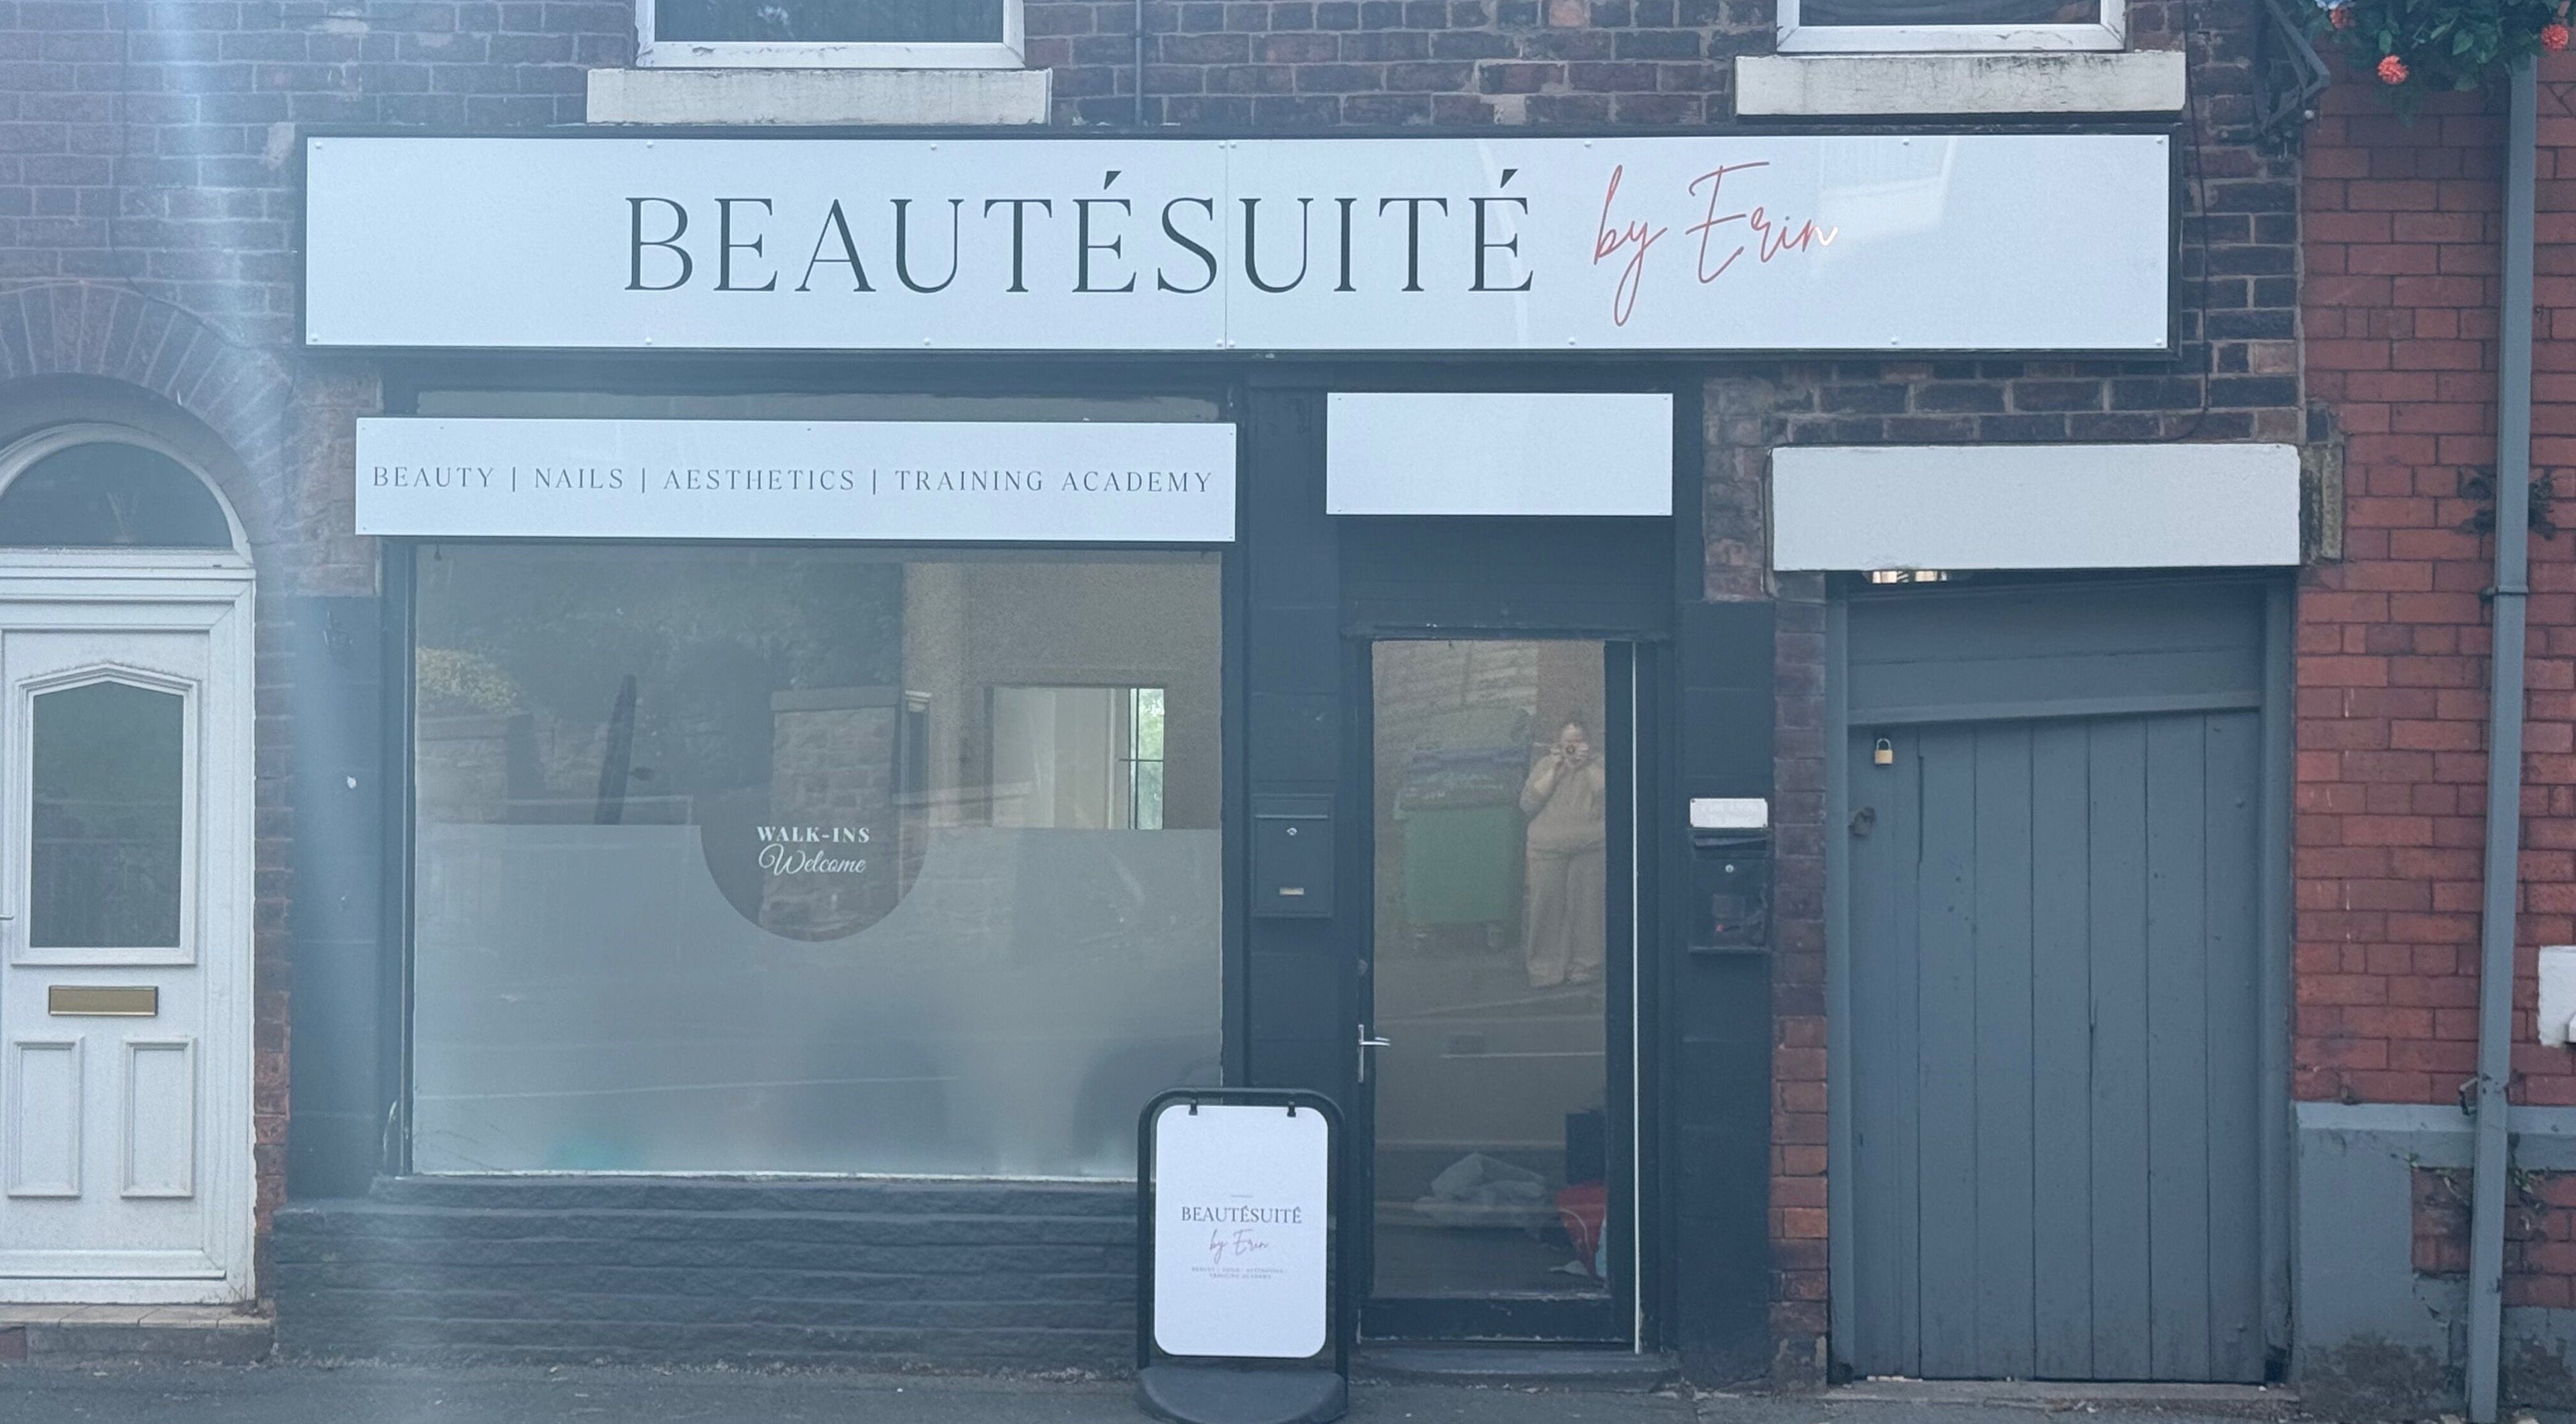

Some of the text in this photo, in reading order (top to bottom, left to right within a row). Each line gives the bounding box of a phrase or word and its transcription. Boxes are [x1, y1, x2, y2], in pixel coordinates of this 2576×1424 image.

[625, 161, 1839, 327] BEAUTÉSUITÉ by Erin
[373, 465, 495, 488] BEAUTY
[535, 468, 624, 490] NAILS
[663, 469, 854, 491] AESTHETICS
[895, 470, 1044, 492] TRAINING
[1061, 471, 1212, 493] ACADEMY
[757, 826, 870, 843] WALK-INS
[758, 843, 867, 876] Welcome
[1181, 1205, 1303, 1224] BEAUTÉSUITÉ
[1209, 1228, 1228, 1265] by
